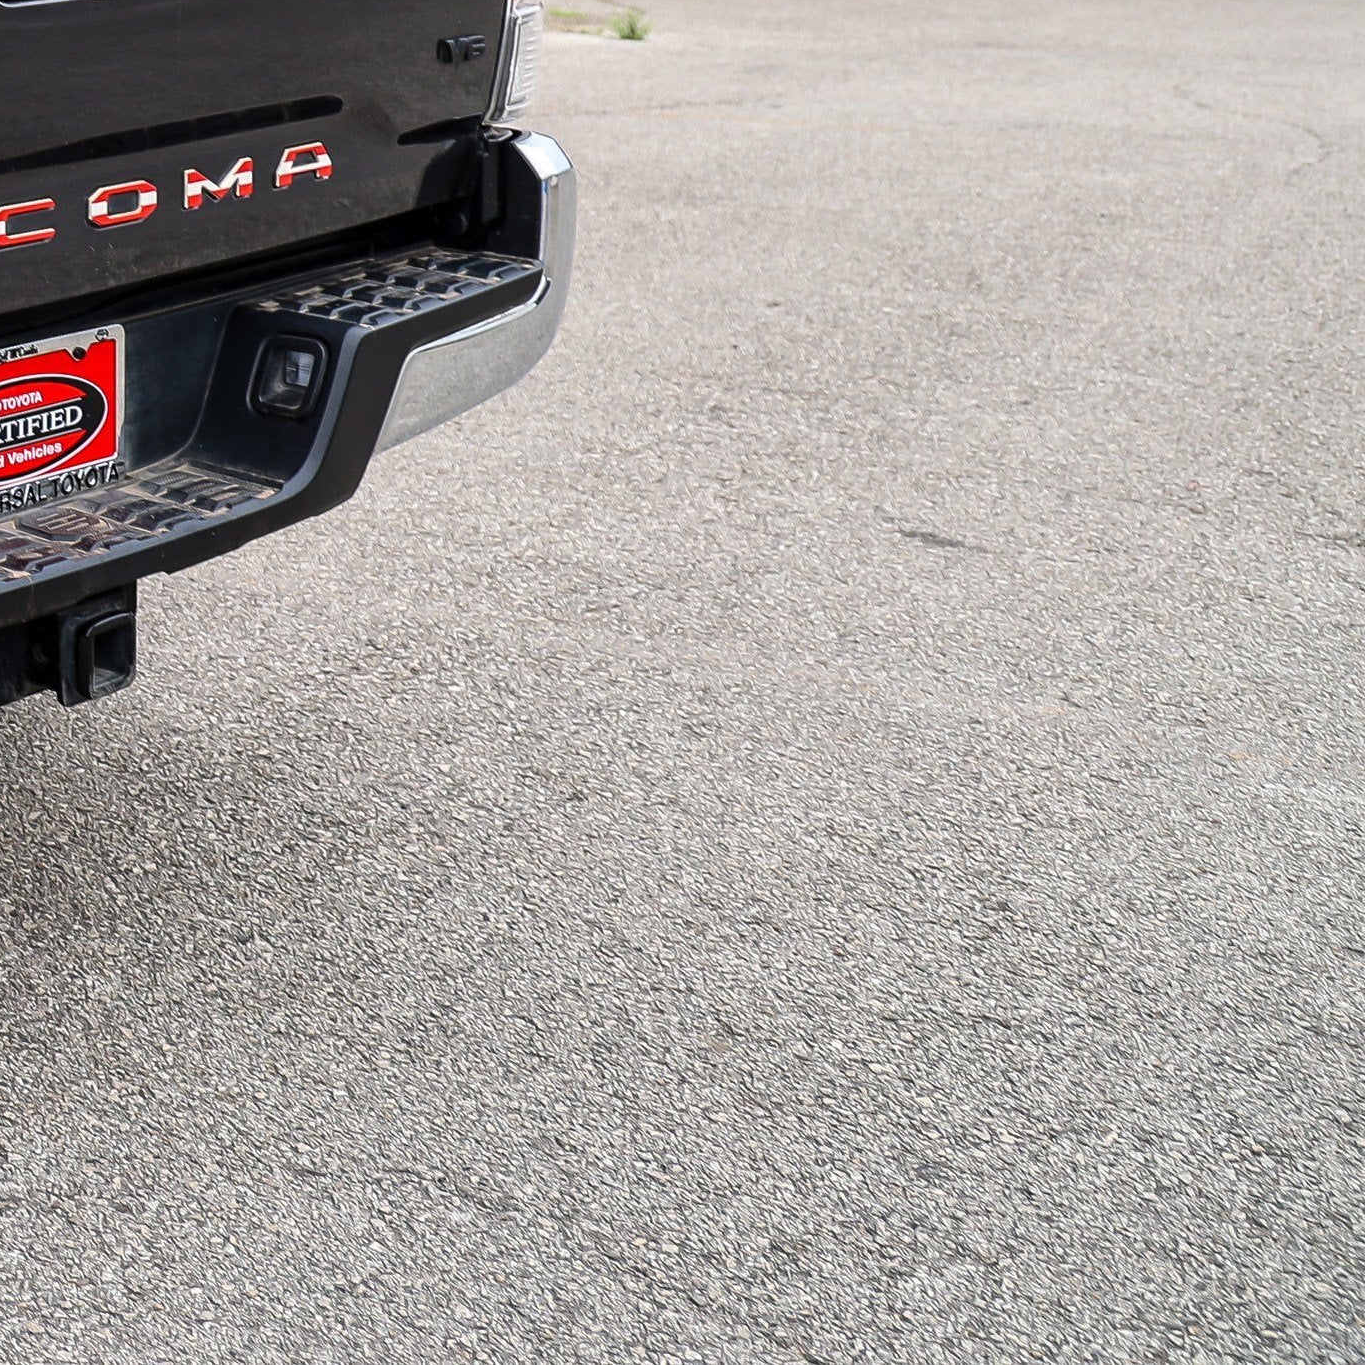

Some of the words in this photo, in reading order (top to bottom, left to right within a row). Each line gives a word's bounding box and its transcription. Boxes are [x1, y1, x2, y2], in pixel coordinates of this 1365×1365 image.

[436, 35, 486, 63] V6
[2, 391, 43, 411] TOYOTA
[7, 442, 63, 465] Vehicles
[52, 461, 119, 496] TOYOTA
